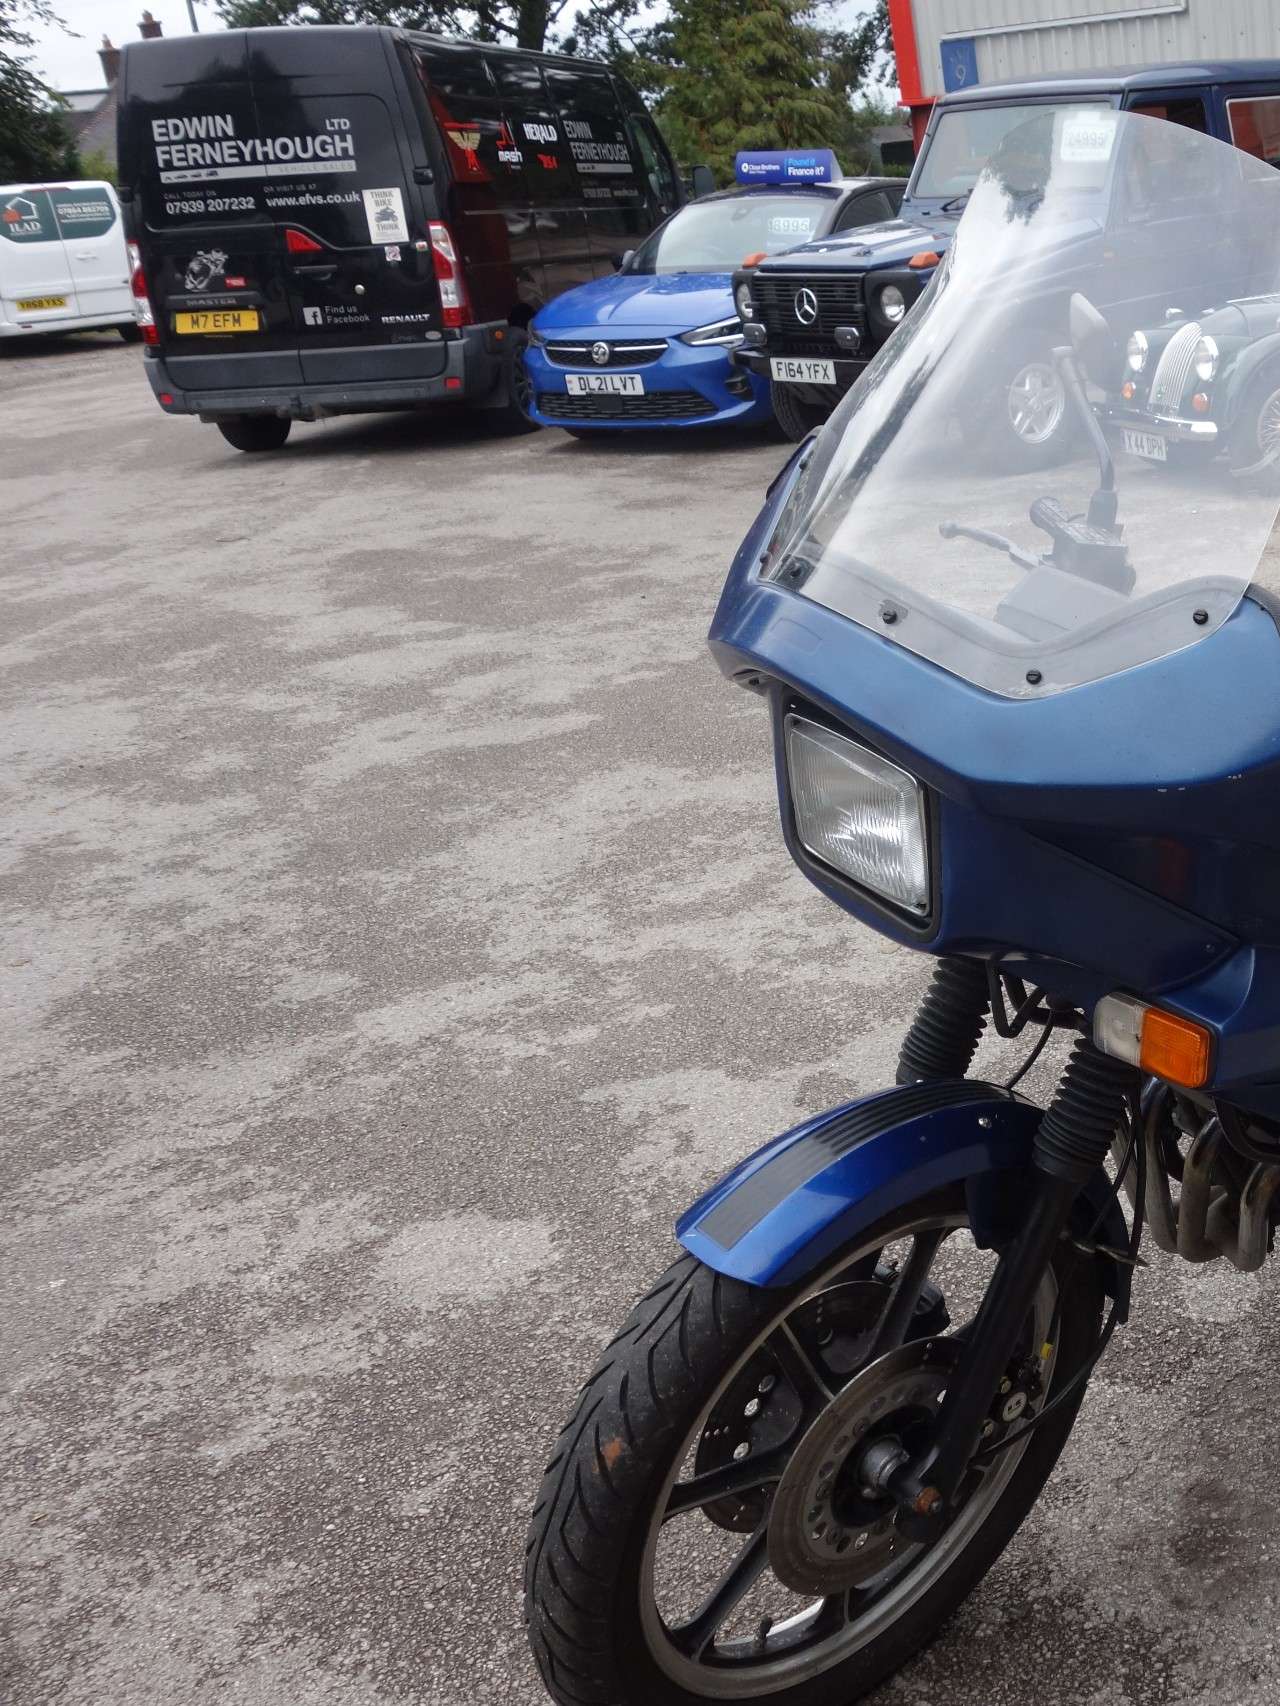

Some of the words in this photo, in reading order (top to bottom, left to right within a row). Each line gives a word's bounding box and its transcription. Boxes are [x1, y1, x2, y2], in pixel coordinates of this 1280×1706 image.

[151, 114, 234, 142] EDWIN
[325, 118, 350, 131] LTD
[562, 120, 593, 138] EDWIN
[522, 123, 558, 144] HERALD
[155, 134, 355, 168] FERNEYHOUGH
[569, 142, 630, 161] FERNEYHOUGH
[788, 167, 814, 176] Finance
[815, 166, 825, 176] it?
[265, 191, 361, 208] www.efvs.co.uk
[370, 190, 394, 199] THINK
[166, 199, 205, 215] 07939
[207, 197, 256, 212] 207232
[374, 199, 393, 207] BIKE
[377, 223, 400, 232] THINK
[186, 298, 237, 306] MASTER
[324, 305, 345, 314] Find
[347, 305, 358, 313] us
[191, 314, 209, 329] M7
[213, 312, 242, 328] EFM
[327, 314, 370, 324] Facebook
[381, 314, 430, 324] RENAULT
[776, 361, 803, 378] F164
[805, 363, 831, 380] YFX
[578, 377, 609, 391] DL21
[611, 376, 636, 391] LVT
